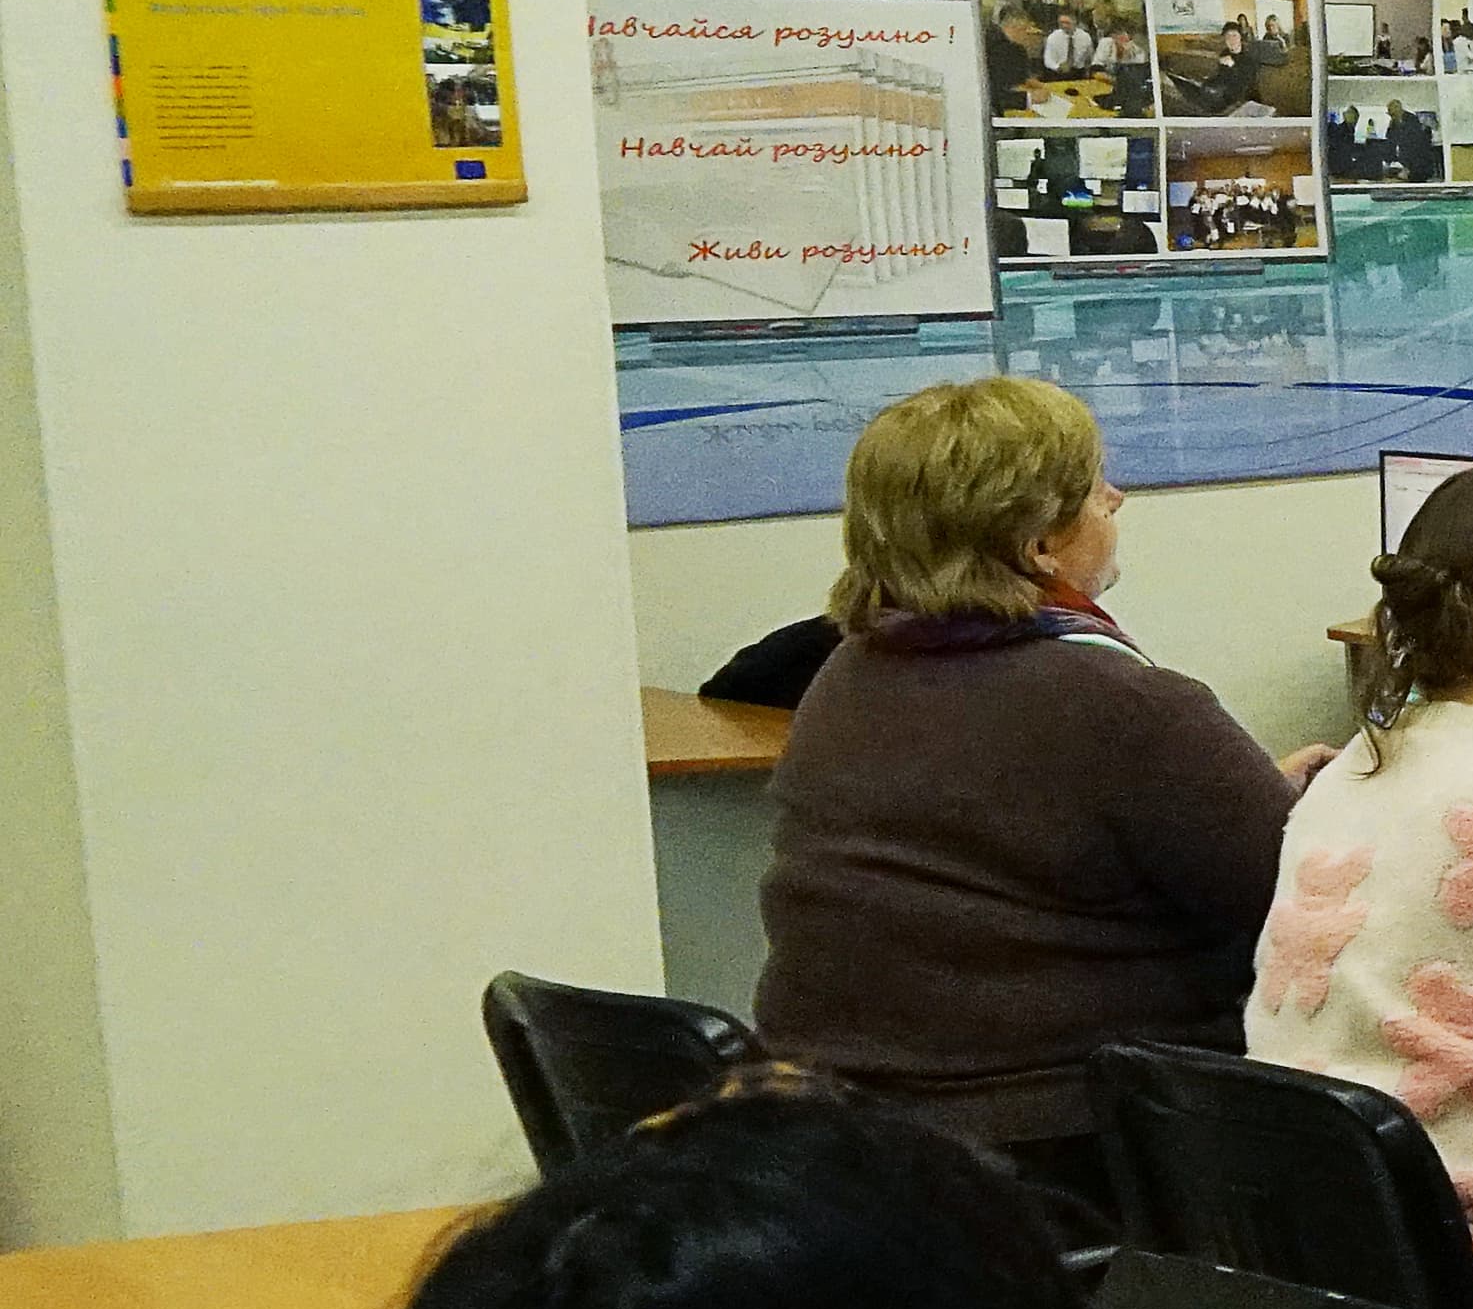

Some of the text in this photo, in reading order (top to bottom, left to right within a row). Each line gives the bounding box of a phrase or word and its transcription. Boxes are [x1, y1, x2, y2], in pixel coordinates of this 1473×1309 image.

[773, 22, 938, 48] розумно
[619, 136, 766, 159] Навчай
[771, 138, 933, 165] розумно
[687, 239, 791, 263] Живи
[801, 241, 955, 266] розумно
